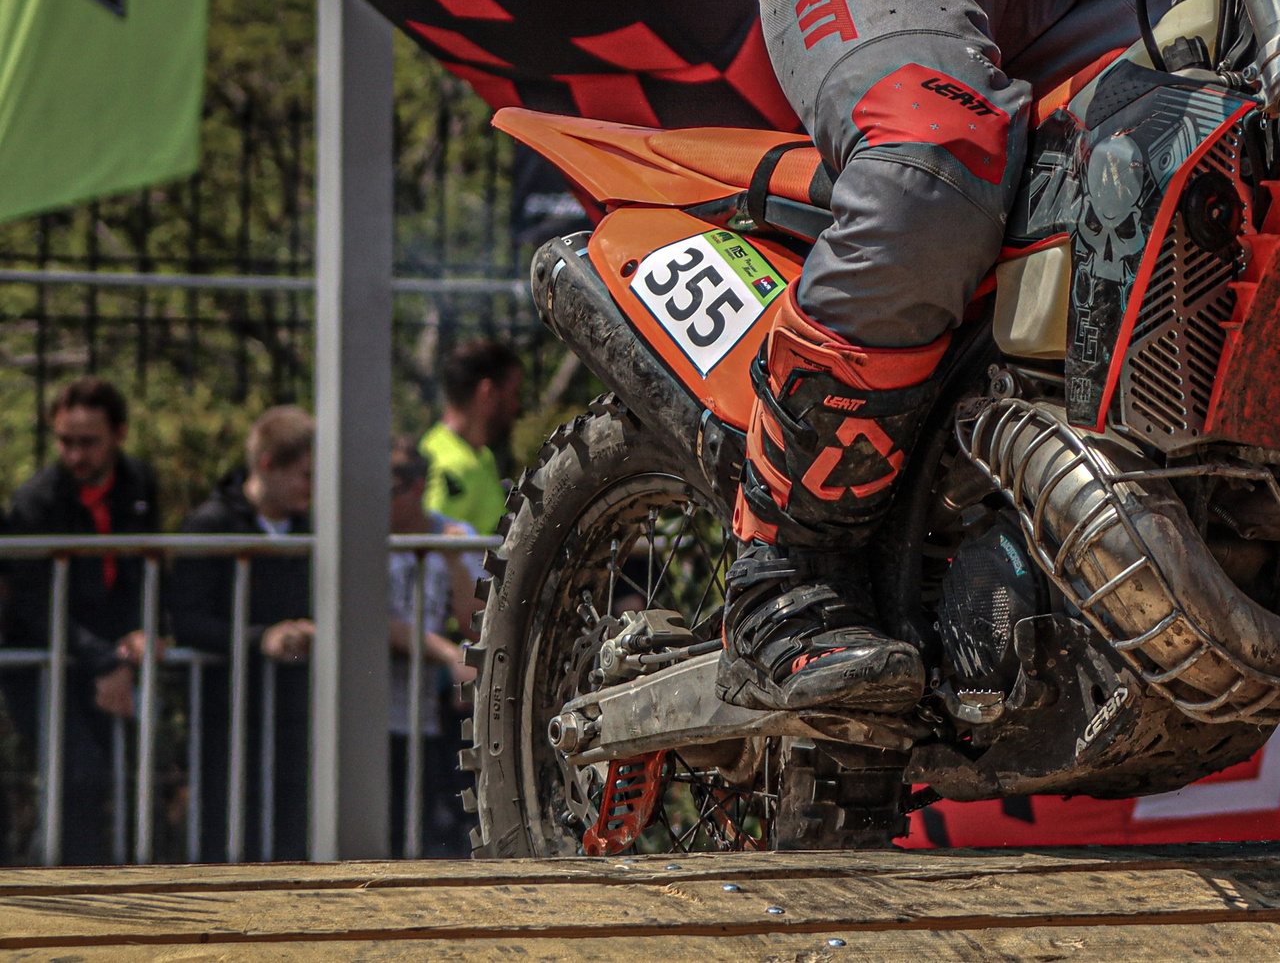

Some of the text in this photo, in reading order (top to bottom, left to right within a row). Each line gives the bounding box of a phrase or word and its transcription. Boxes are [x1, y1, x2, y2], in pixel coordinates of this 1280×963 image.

[920, 77, 1000, 118] LEATT
[643, 247, 745, 348] 355
[823, 394, 867, 412] LEATT
